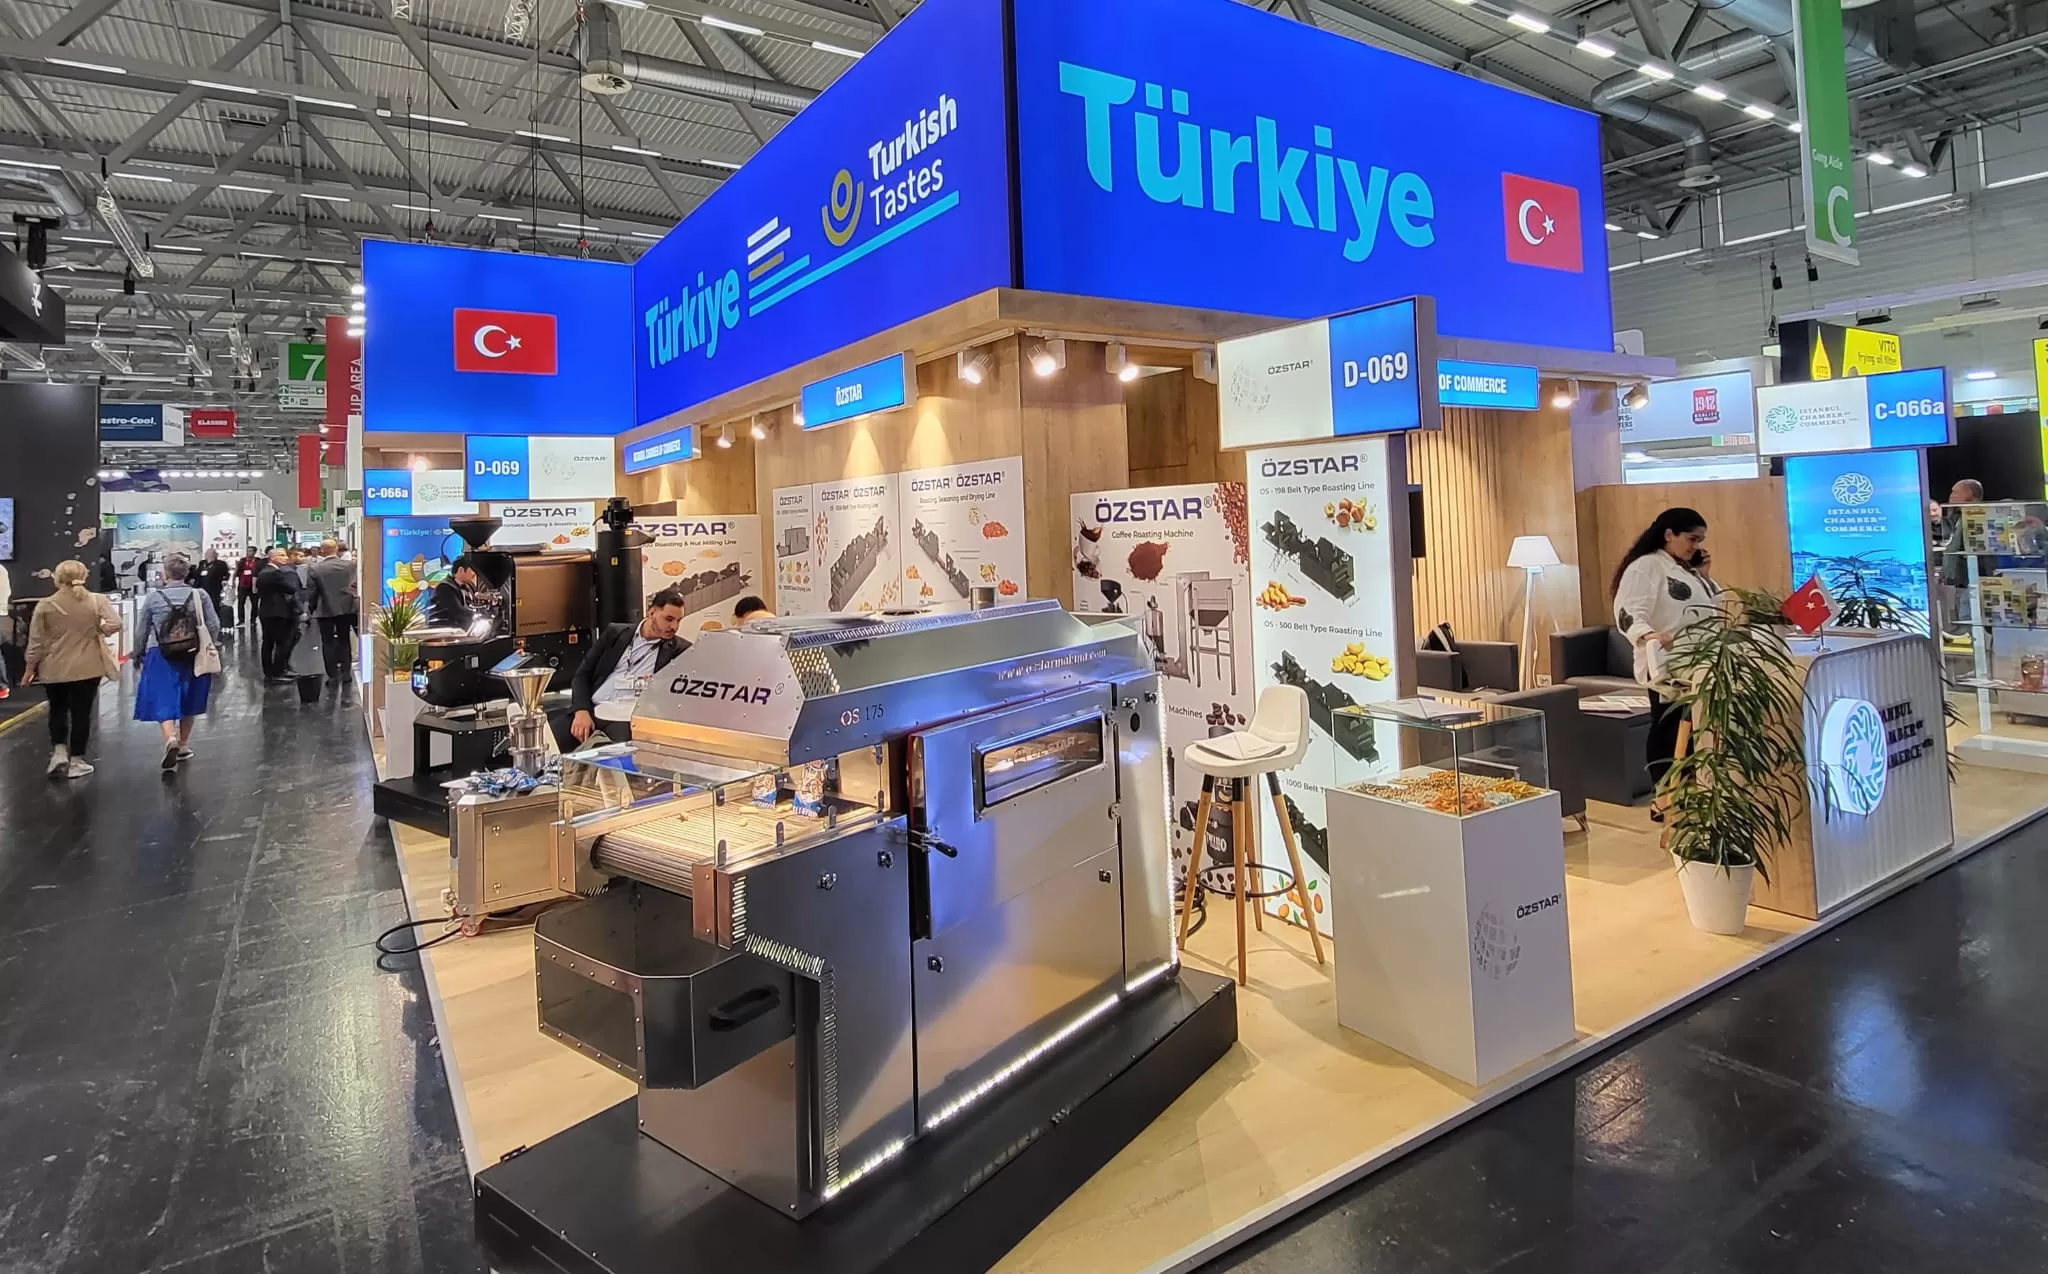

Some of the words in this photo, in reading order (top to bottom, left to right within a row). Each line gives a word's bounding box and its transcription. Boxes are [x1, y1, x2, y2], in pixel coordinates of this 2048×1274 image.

[868, 94, 958, 181] Turkish
[1059, 61, 1435, 263] Türkiye
[870, 158, 944, 225] Tastes
[1828, 185, 1851, 248] C
[644, 268, 740, 369] Türkiye
[1879, 339, 1896, 353] VITO
[302, 354, 325, 381] 7
[1343, 351, 1408, 388] D-069
[1438, 374, 1452, 390] OF
[1453, 375, 1507, 393] COMMERCE
[835, 384, 863, 407] ÖZSTAR
[1799, 405, 1841, 415] ISTANBUL
[1799, 412, 1843, 421] CHAMBER
[1875, 399, 1945, 420] C-066a
[100, 416, 155, 425] astro-Cool
[1799, 419, 1846, 428] COMMERCE
[474, 460, 520, 476] D-069
[1261, 455, 1359, 478] ÖZSTAR
[911, 478, 950, 492] ÖZSTAR
[956, 472, 1001, 488] ÖZSTAR
[1287, 486, 1302, 494] Belt
[1303, 485, 1320, 495] Type
[1322, 483, 1356, 493] Roasting
[1358, 481, 1375, 490] Line
[367, 487, 409, 499] C-066a
[502, 506, 577, 518] ÖZSTAR
[1095, 497, 1203, 523] ÖZSTAR
[400, 528, 430, 536] Türkiye
[1112, 530, 1132, 539] Coffee
[1133, 530, 1162, 540] Roasting
[1164, 529, 1194, 538] Machine
[1824, 525, 1887, 533] COMMERCE
[1279, 621, 1293, 629] 500
[1294, 622, 1308, 631] Belt
[1309, 624, 1328, 634] Type
[1329, 625, 1364, 638] Roasting
[1366, 628, 1383, 638] Line
[669, 674, 772, 706] ÖZSTAR
[840, 707, 860, 727] OS
[865, 703, 884, 721] 175
[1168, 704, 1203, 719] Machines
[1285, 777, 1302, 788] 1000
[1303, 782, 1319, 792] Belt
[1516, 895, 1559, 919] ÖZSTAR
